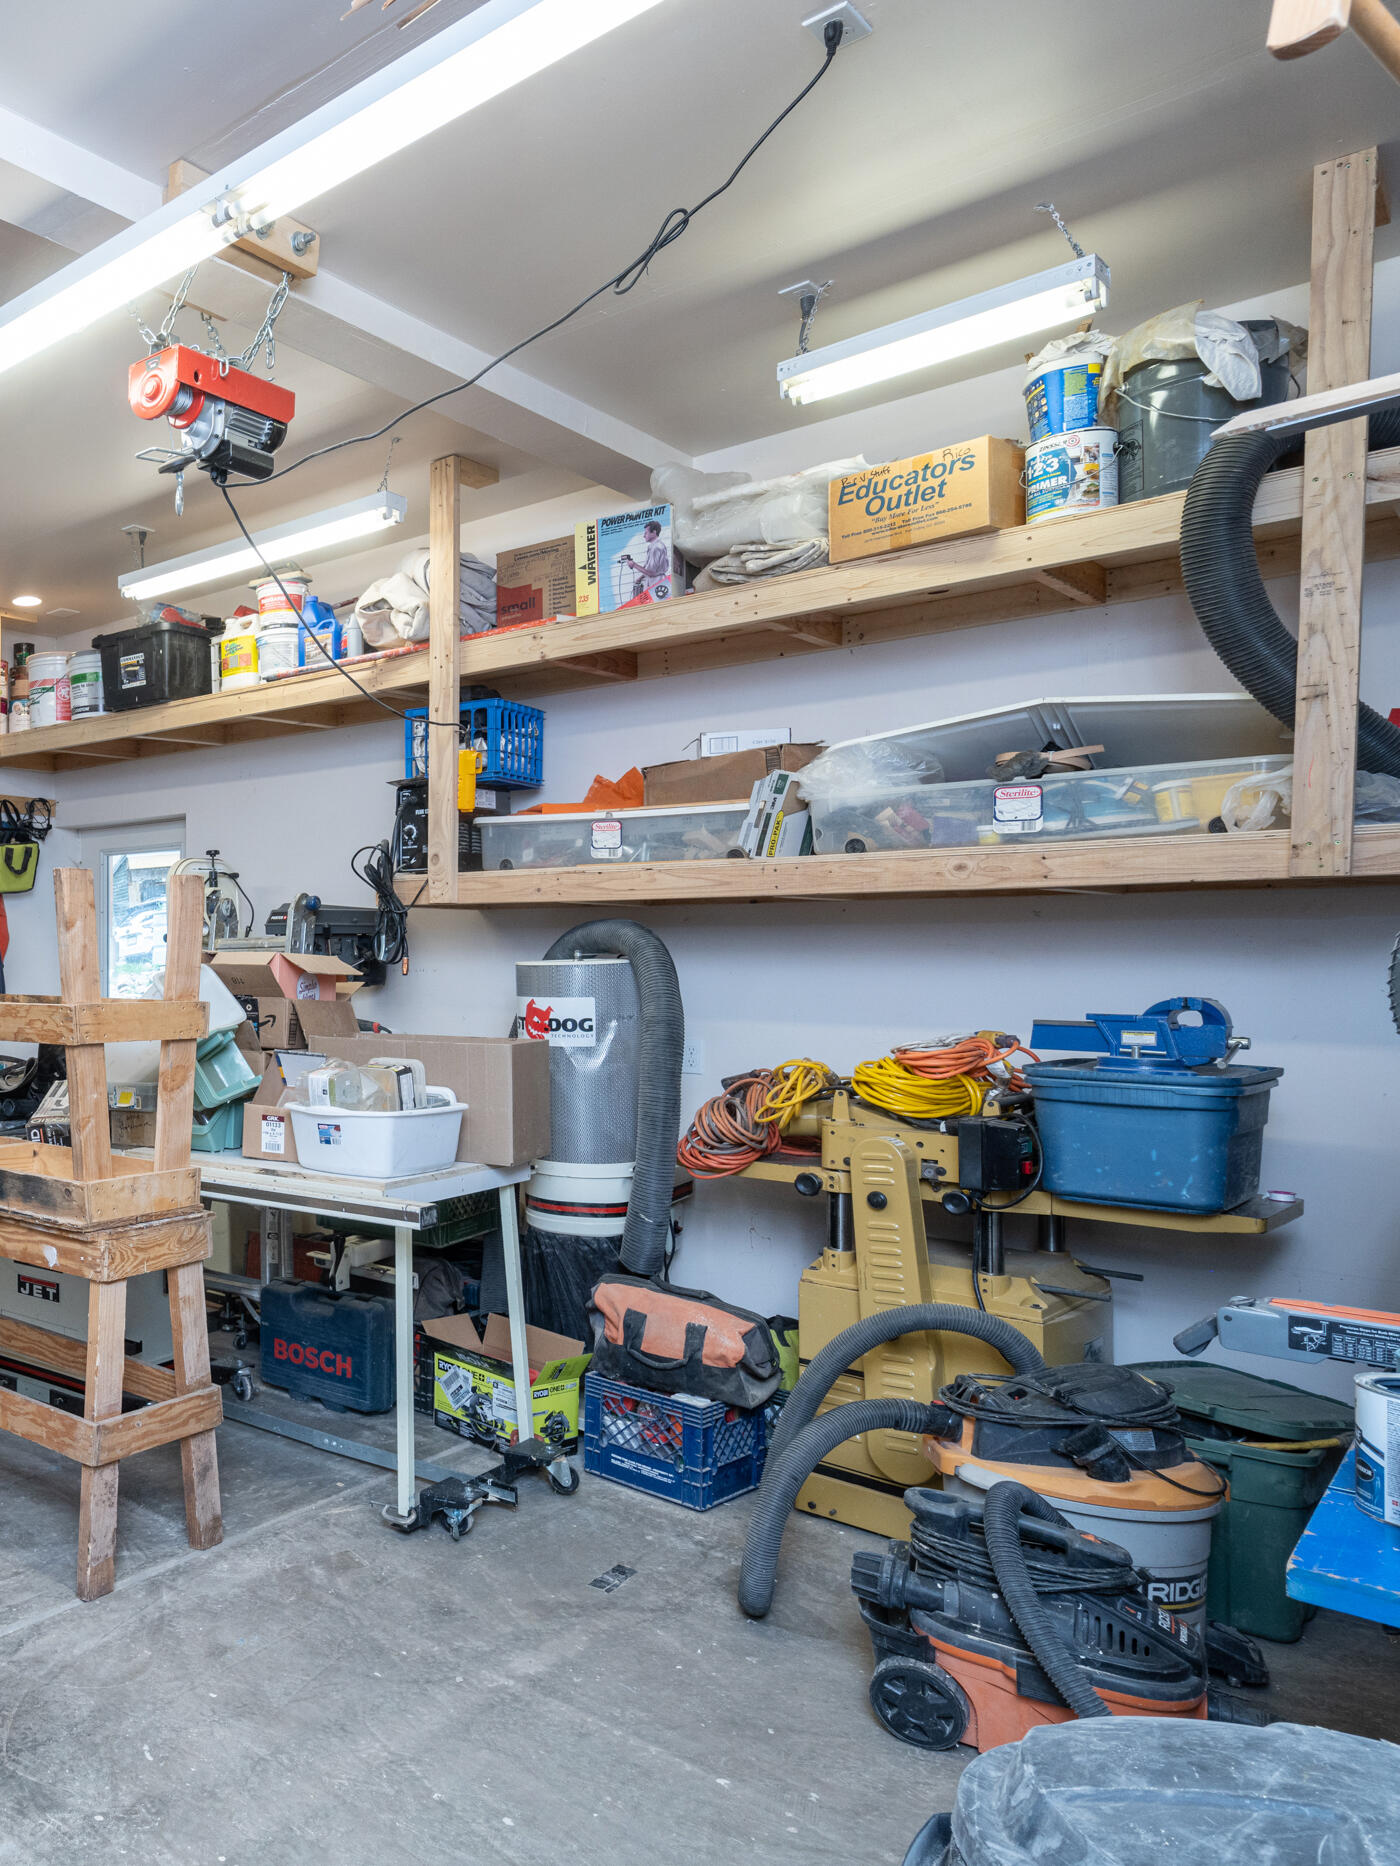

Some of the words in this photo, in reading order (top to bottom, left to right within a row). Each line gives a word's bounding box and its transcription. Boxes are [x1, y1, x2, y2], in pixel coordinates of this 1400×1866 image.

[838, 454, 976, 506] Educators
[865, 478, 948, 517] Outlet
[601, 514, 626, 528] POWER
[625, 508, 654, 523] PAINTER
[653, 505, 667, 517] KIT
[586, 525, 597, 586] WAGNER
[501, 596, 536, 614] small
[999, 788, 1036, 798] Sterilite
[548, 1017, 594, 1033] DOG
[20, 1282, 57, 1301] JET
[273, 1337, 353, 1379] BOSCH
[533, 1389, 549, 1399] RYOBI
